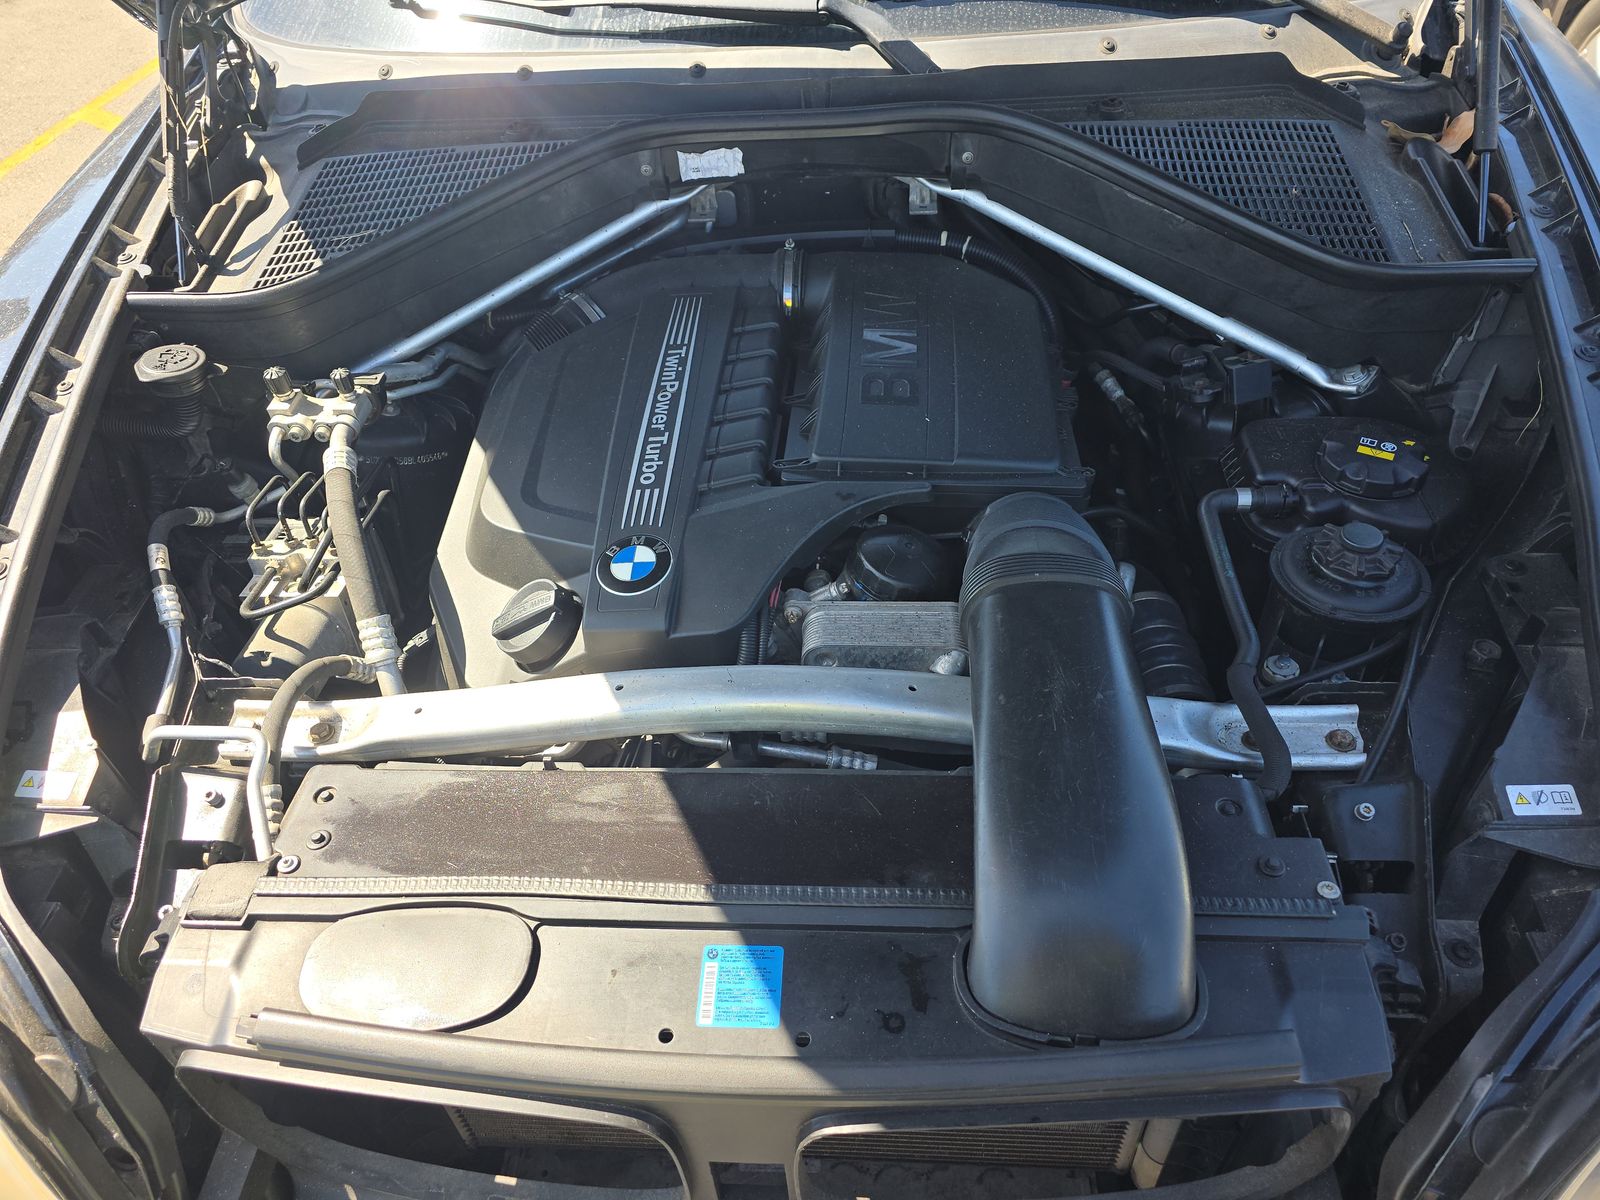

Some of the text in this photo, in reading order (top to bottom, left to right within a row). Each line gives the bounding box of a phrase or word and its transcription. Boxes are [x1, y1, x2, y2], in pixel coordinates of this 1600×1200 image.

[862, 291, 918, 405] BMW
[639, 345, 687, 486] TwinPower Turbo
[606, 535, 669, 557] BMW
